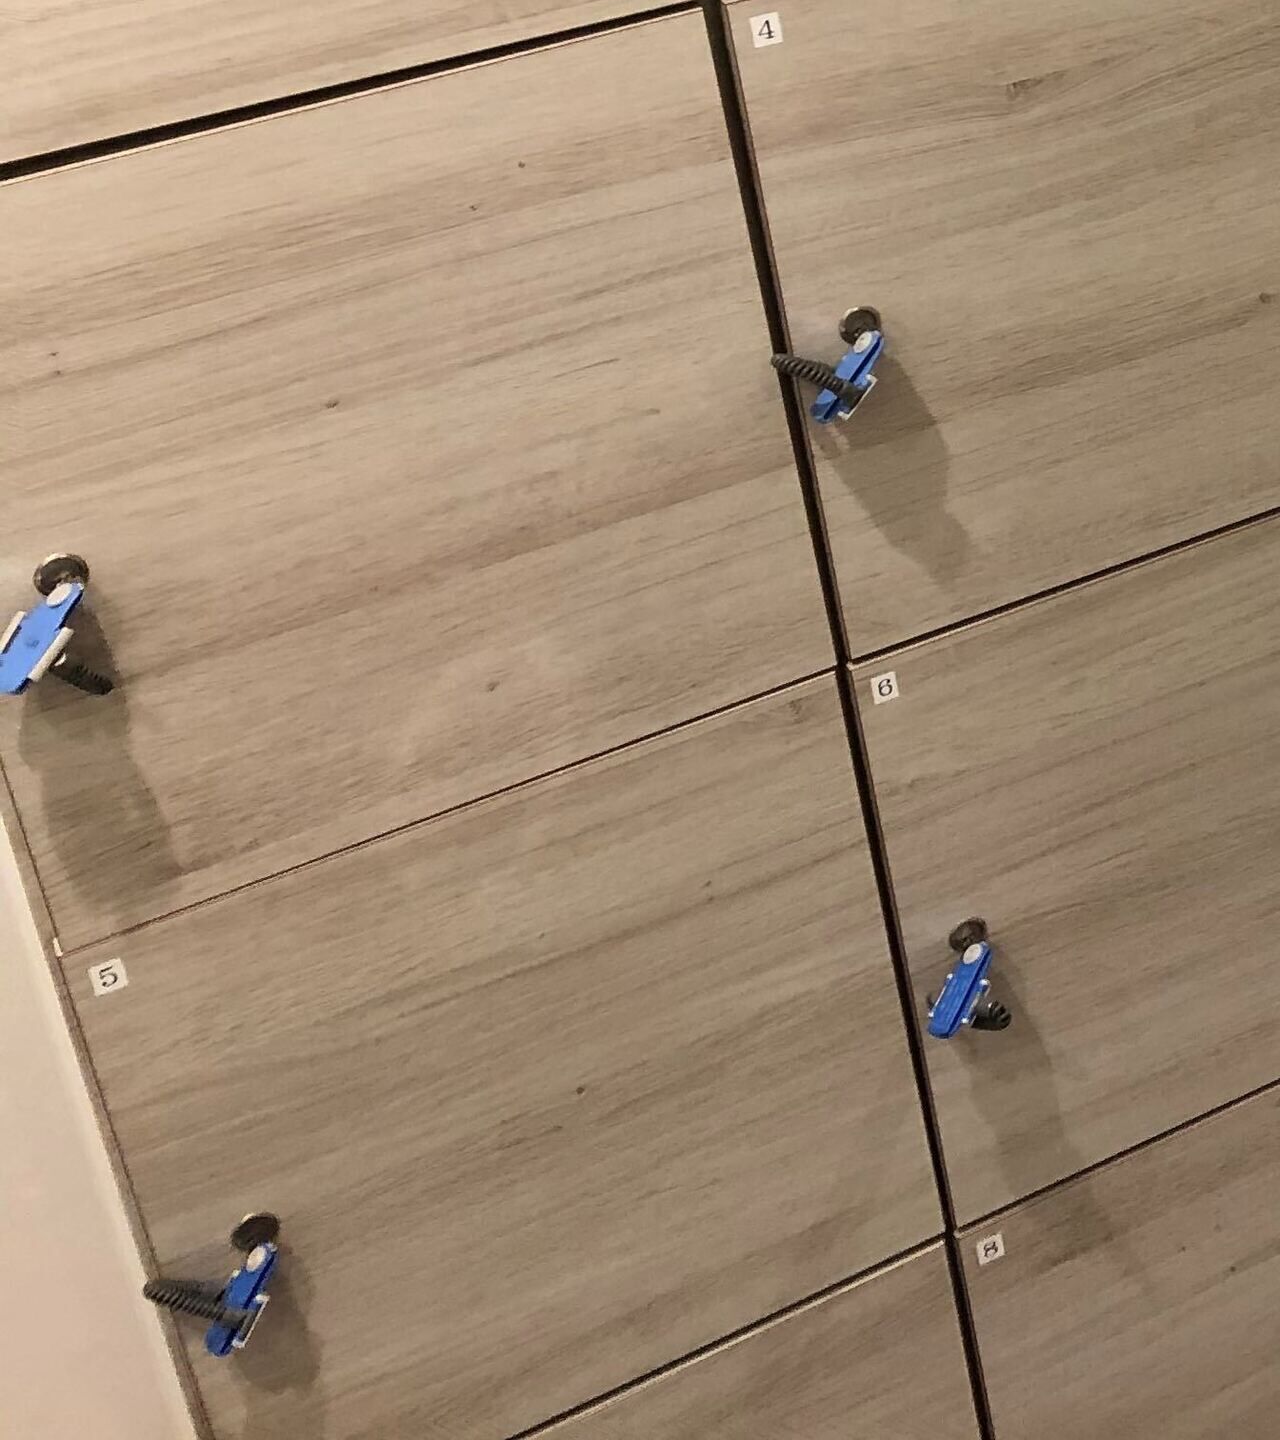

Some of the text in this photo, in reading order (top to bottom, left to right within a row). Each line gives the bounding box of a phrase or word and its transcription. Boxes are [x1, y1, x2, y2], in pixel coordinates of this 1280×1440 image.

[758, 20, 775, 39] 4
[878, 678, 893, 697] 6
[99, 965, 118, 988] 5
[983, 1241, 999, 1258] 8
